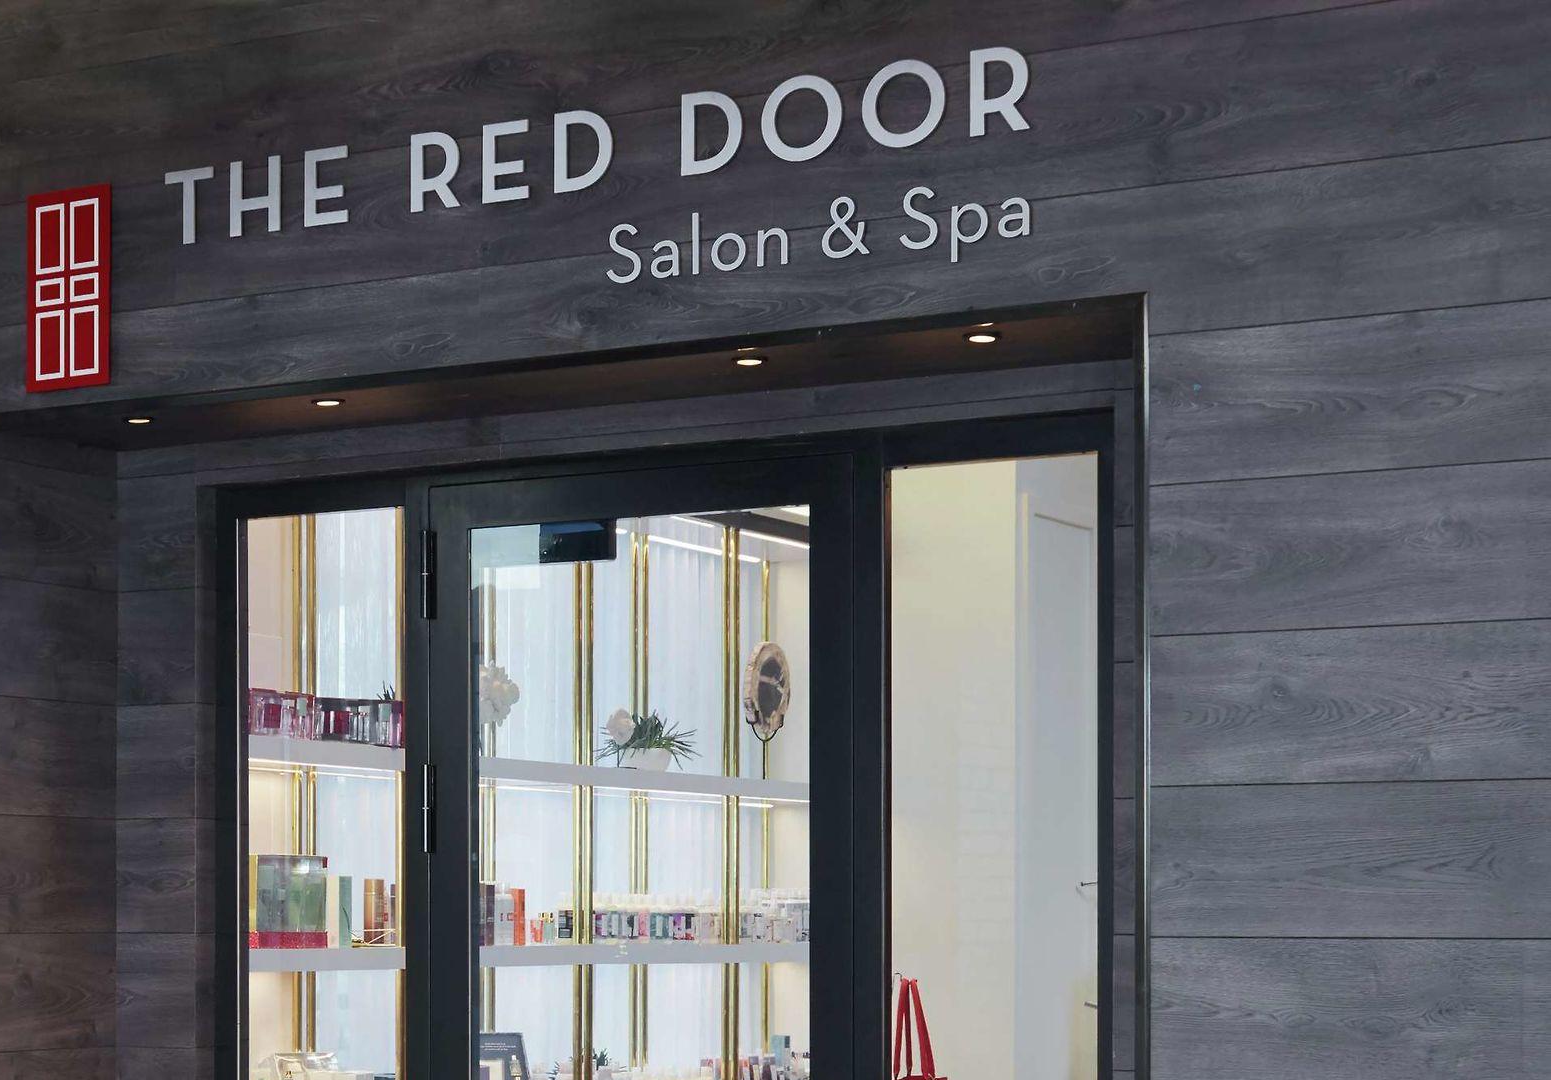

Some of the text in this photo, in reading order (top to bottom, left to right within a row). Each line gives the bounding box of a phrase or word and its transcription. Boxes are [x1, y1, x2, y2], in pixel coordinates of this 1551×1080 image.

[164, 46, 1031, 246] THE RED DOOR
[605, 186, 1032, 284] Salon & Spa
